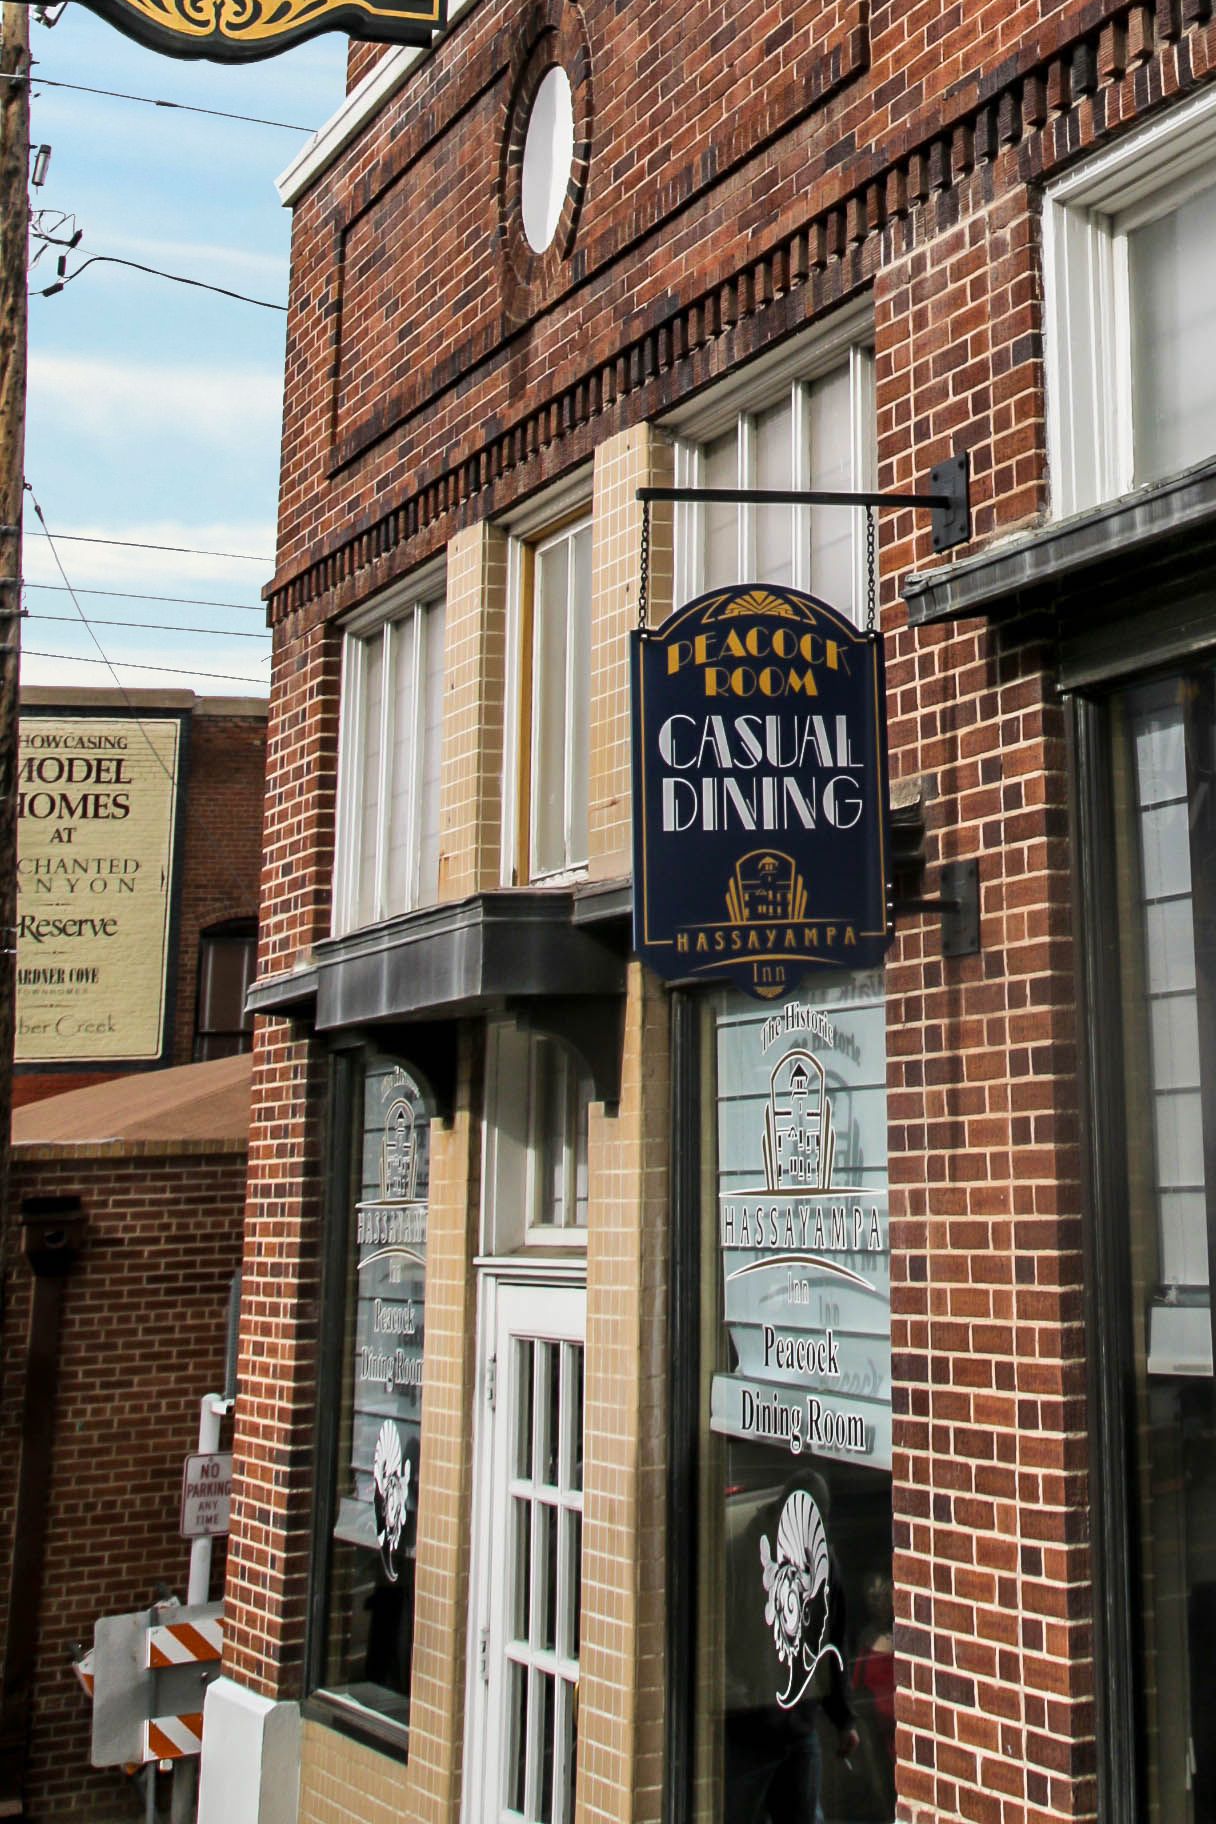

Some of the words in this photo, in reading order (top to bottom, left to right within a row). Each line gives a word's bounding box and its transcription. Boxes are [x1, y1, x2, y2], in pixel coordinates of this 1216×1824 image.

[666, 625, 852, 675] PEACOCK
[704, 667, 818, 697] ROOM
[18, 734, 127, 750] HOWCASING
[658, 714, 864, 769] CASUAL
[662, 775, 863, 832] DINING
[49, 827, 77, 844] AT
[17, 858, 141, 874] CHANTED
[16, 877, 136, 893] NYON
[16, 914, 119, 943] Reserve
[676, 926, 857, 954] HASSAYAMPA
[17, 967, 65, 985] ARDNER
[752, 962, 785, 983] Inn
[760, 1015, 782, 1056] The
[783, 1001, 834, 1047] Historic
[724, 1205, 883, 1251] HASSAYAMPA
[787, 1271, 809, 1304] Inn
[374, 1298, 415, 1334] Peacock
[762, 1325, 840, 1376] Peacock
[360, 1346, 394, 1392] Dining
[741, 1389, 801, 1455] Dining
[806, 1396, 865, 1451] Room
[200, 1462, 220, 1479] NO
[187, 1481, 232, 1498] PARKING
[196, 1514, 219, 1526] TIME
[198, 1501, 218, 1512] ANY
